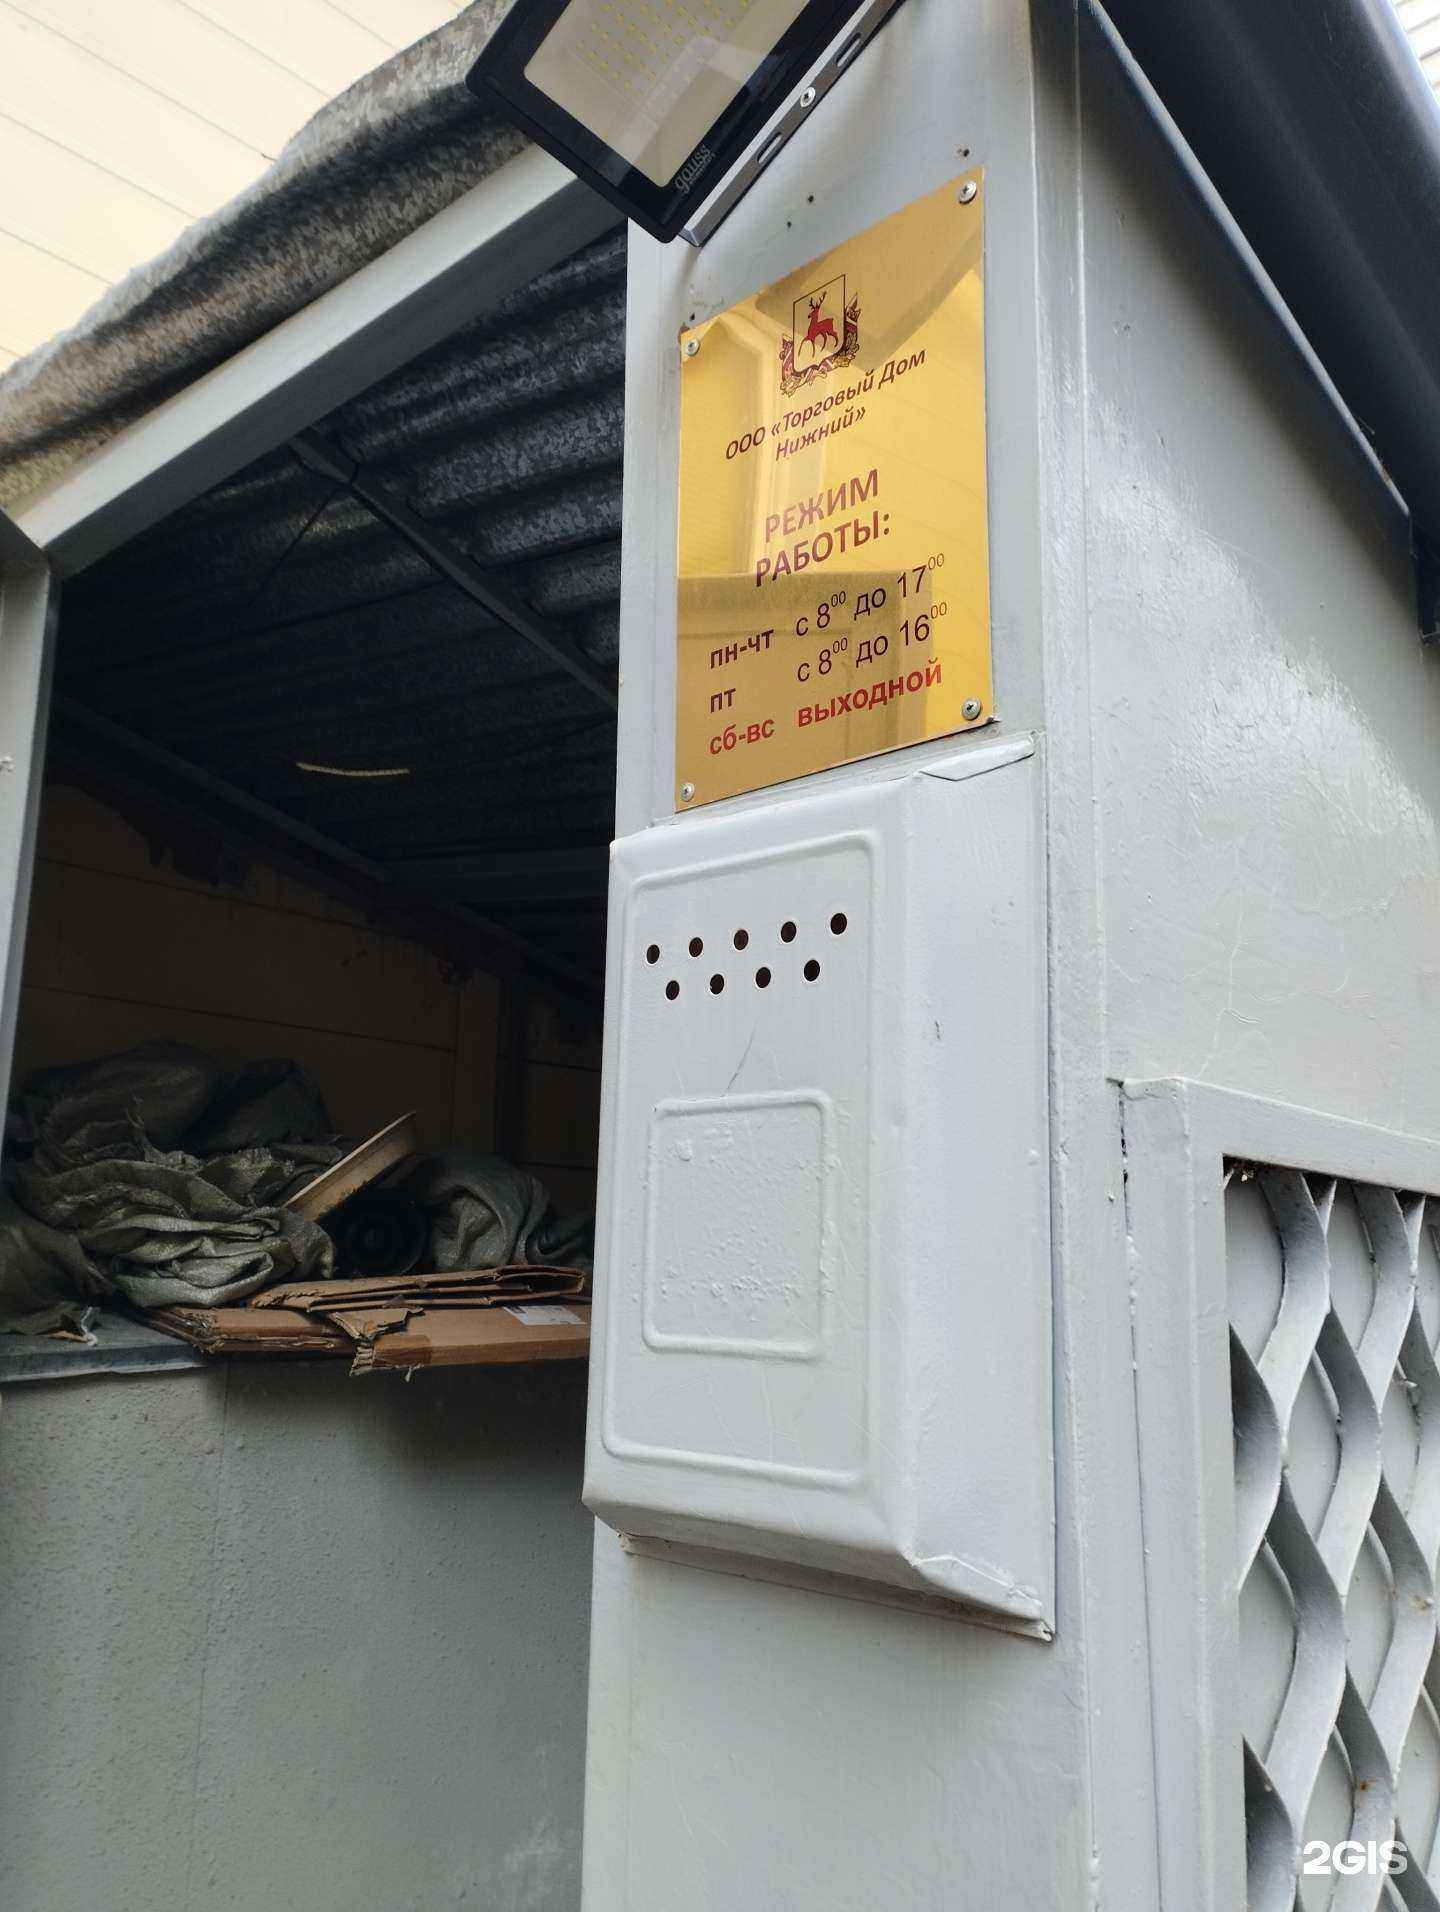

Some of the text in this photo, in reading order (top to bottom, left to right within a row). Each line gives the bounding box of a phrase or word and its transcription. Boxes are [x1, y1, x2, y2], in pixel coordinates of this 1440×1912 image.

[674, 144, 716, 194] gauss
[726, 349, 926, 460] ООО «Торговый Дом
[775, 405, 867, 461] Нижний»
[765, 468, 879, 544] РЕЖИМ
[756, 511, 890, 587] РАБОТЫ:
[853, 587, 887, 621] до
[855, 635, 889, 668] до
